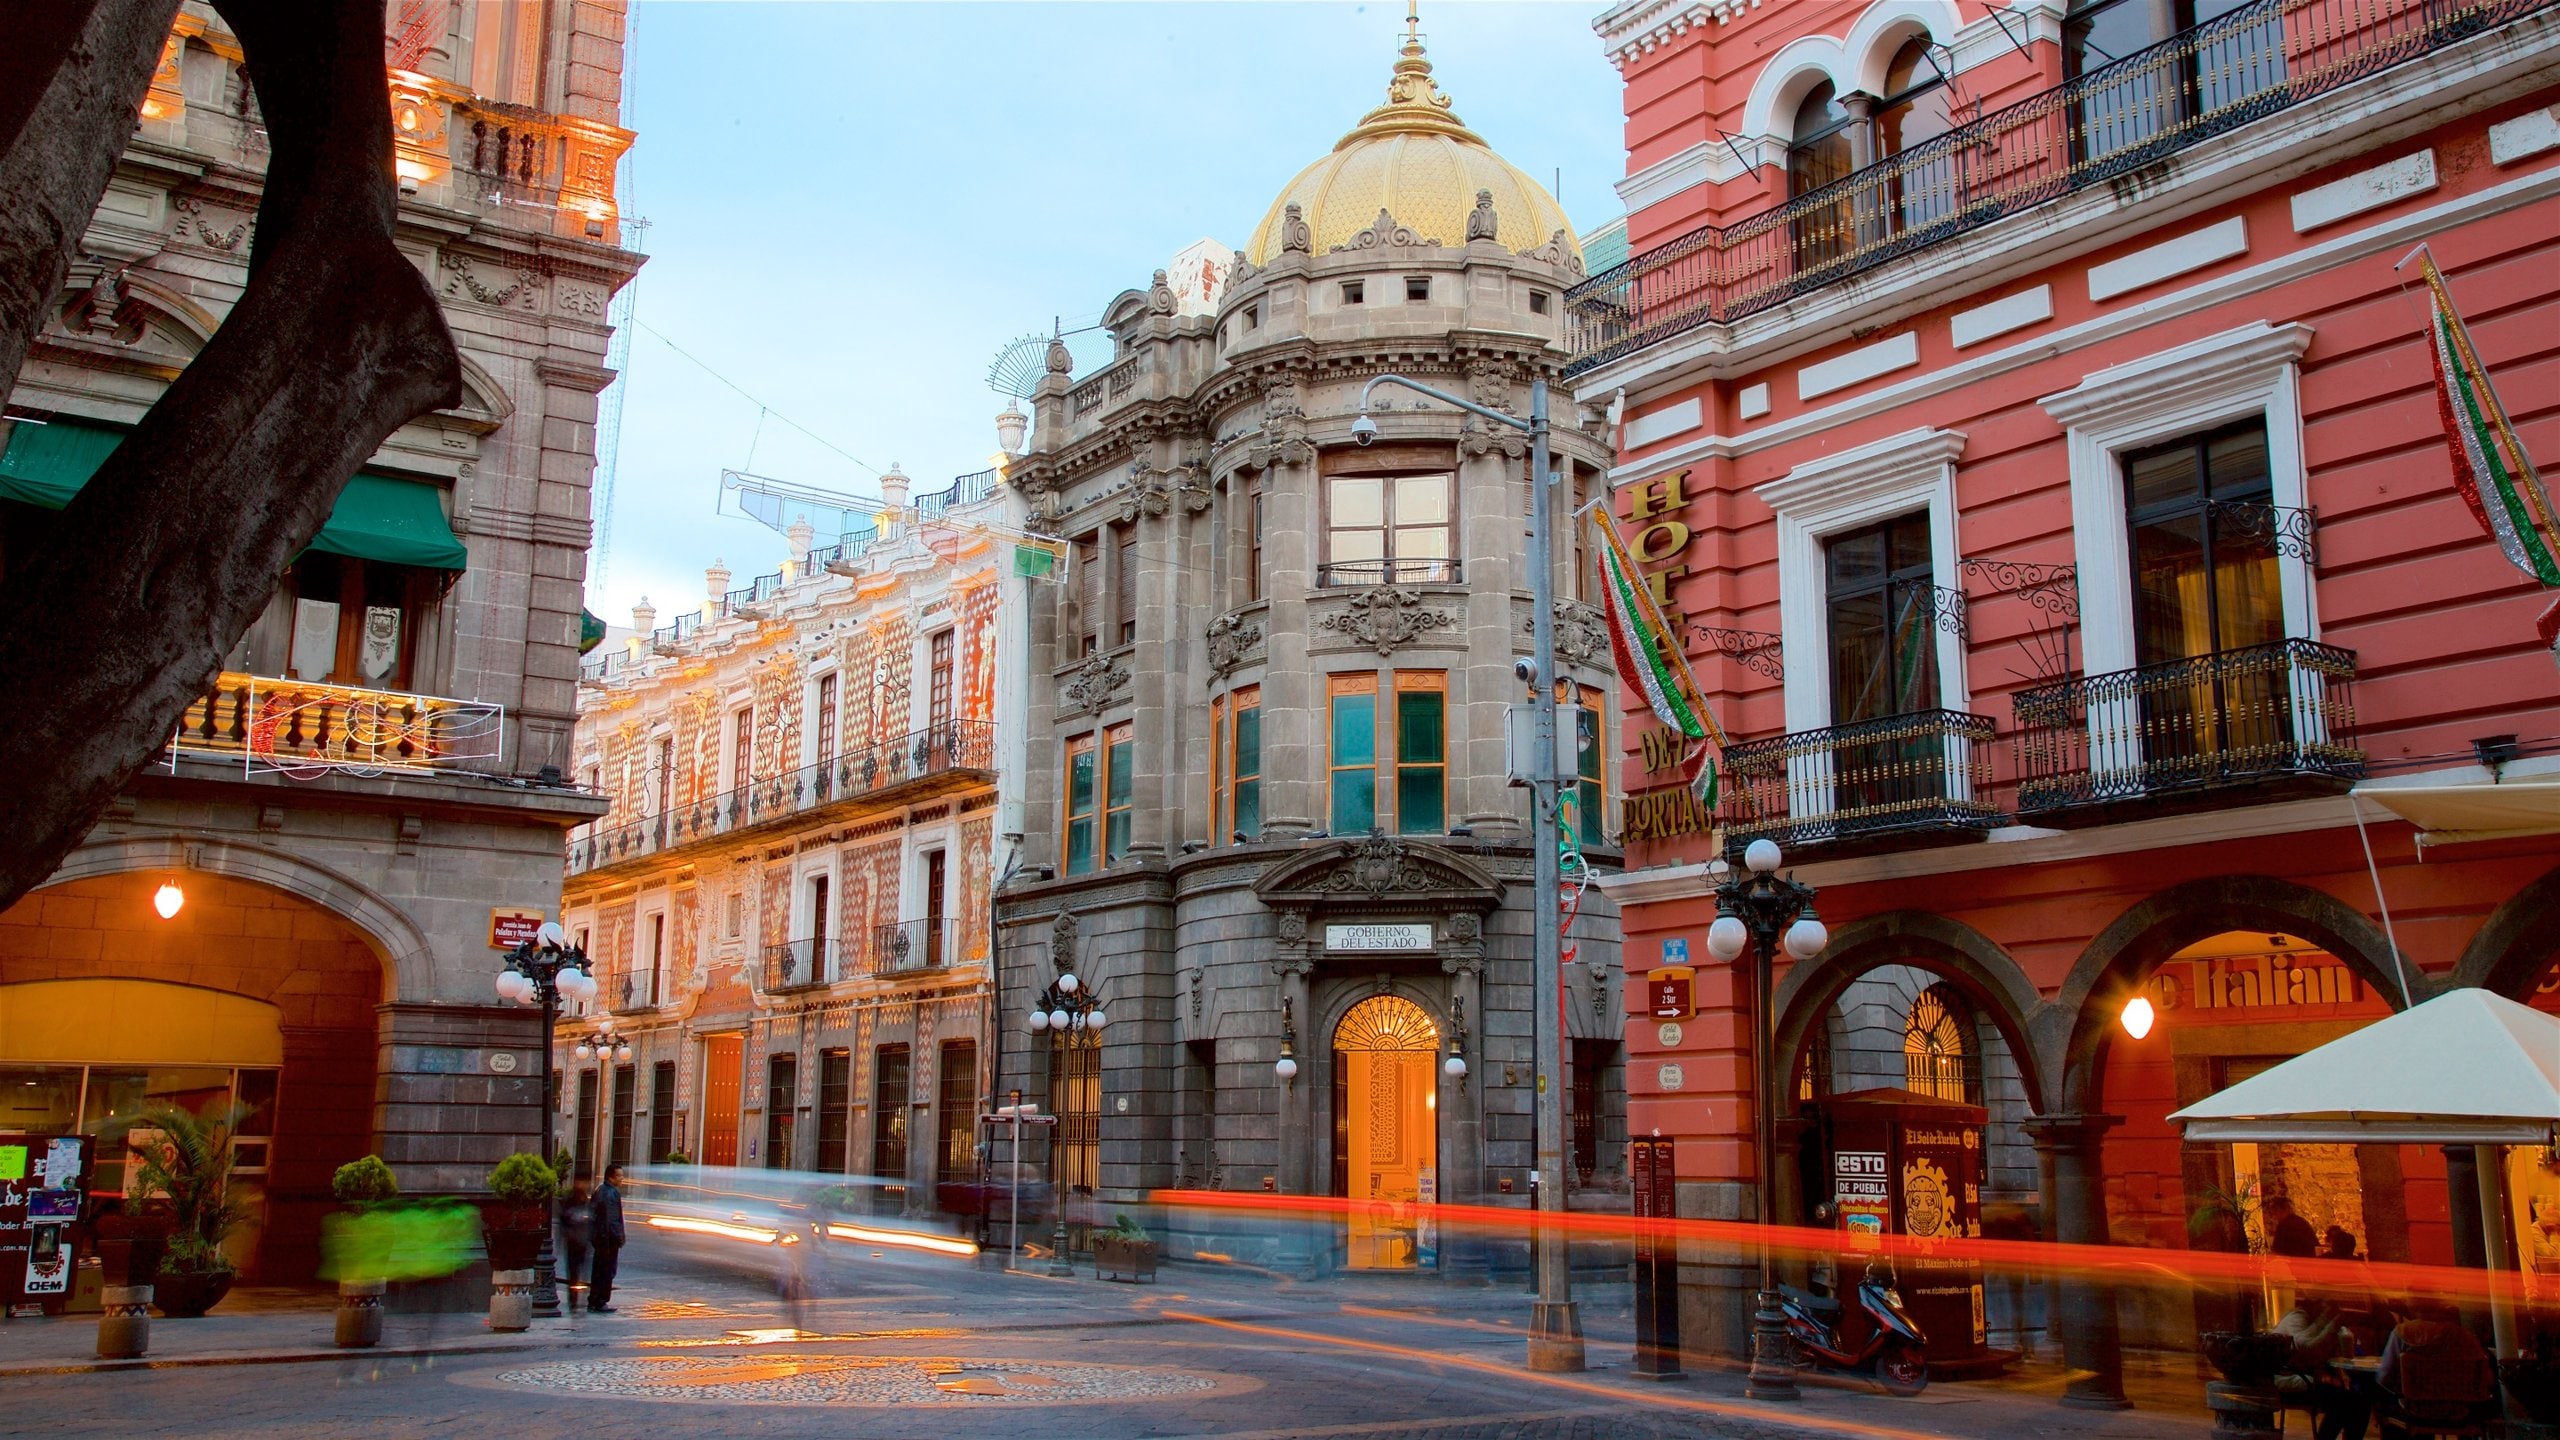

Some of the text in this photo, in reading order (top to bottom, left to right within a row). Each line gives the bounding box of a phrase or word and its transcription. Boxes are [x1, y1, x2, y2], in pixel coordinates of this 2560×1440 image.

[1626, 470, 1692, 707] HOTE
[1347, 927, 1411, 938] GOBIERNO
[1341, 938, 1417, 948] DEL ESTADO
[2192, 955, 2353, 1009] Italian
[1663, 986, 1674, 994] Calle
[1667, 995, 1676, 1004] Sur
[1840, 1183, 1886, 1194] DE PUEBLA
[0, 1221, 20, 1230] oder
[28, 1281, 62, 1292] OEM
